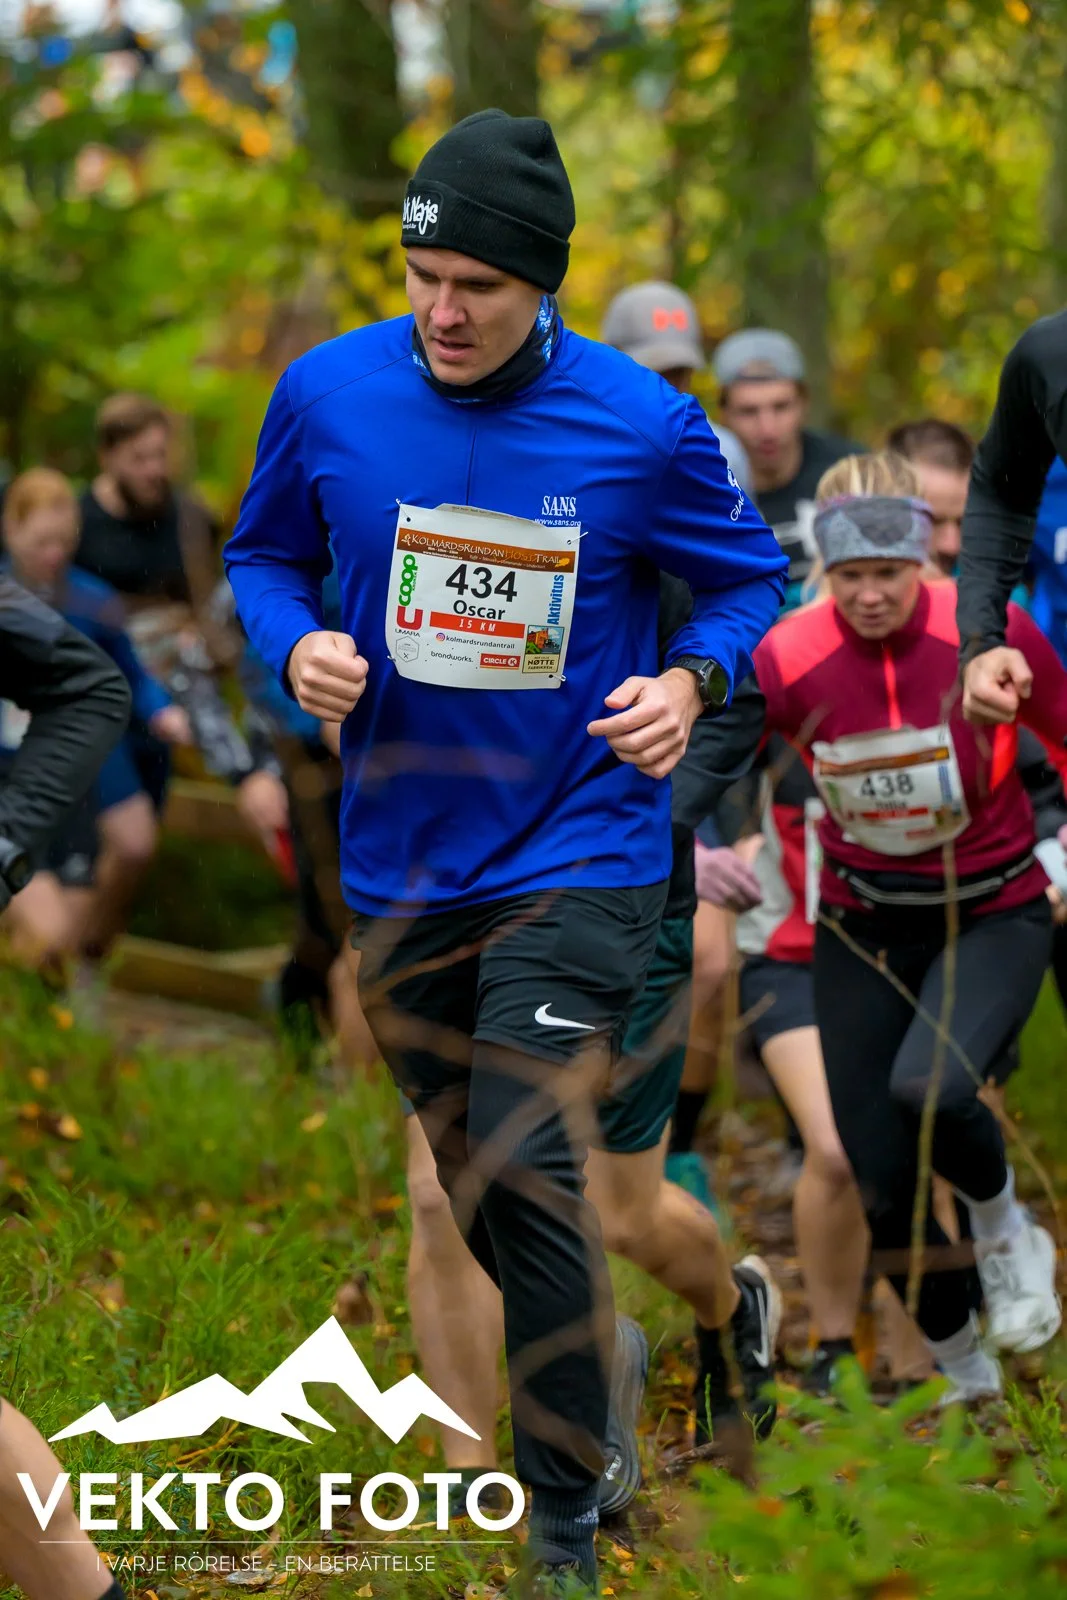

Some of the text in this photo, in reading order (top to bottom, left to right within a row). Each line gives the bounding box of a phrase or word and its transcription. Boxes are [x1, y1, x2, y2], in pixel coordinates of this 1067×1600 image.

[542, 495, 577, 518] SANS
[398, 554, 418, 607] coop
[445, 563, 518, 603] 434
[453, 599, 506, 620] Oscar
[547, 574, 565, 626] Aktivitus
[395, 628, 421, 638] UMARA
[480, 622, 496, 632] KM
[446, 635, 516, 649] kolmardsrundantrail
[483, 657, 517, 666] CIRCLE K
[860, 773, 914, 798] 438
